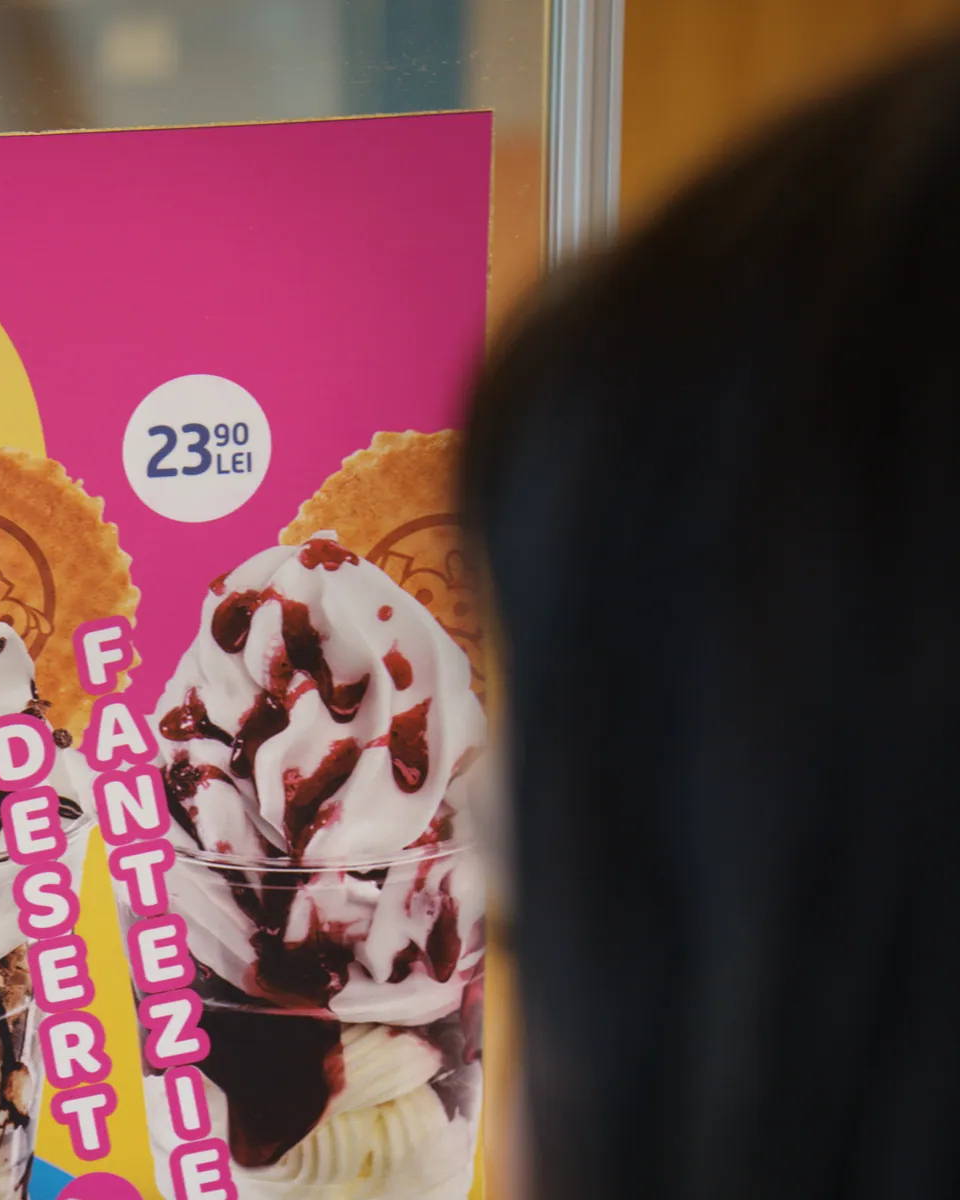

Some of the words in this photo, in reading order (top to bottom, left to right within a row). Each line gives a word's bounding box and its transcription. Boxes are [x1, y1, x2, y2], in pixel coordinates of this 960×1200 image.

[146, 423, 212, 478] 23
[214, 422, 249, 447] 90
[216, 452, 252, 475] LEI
